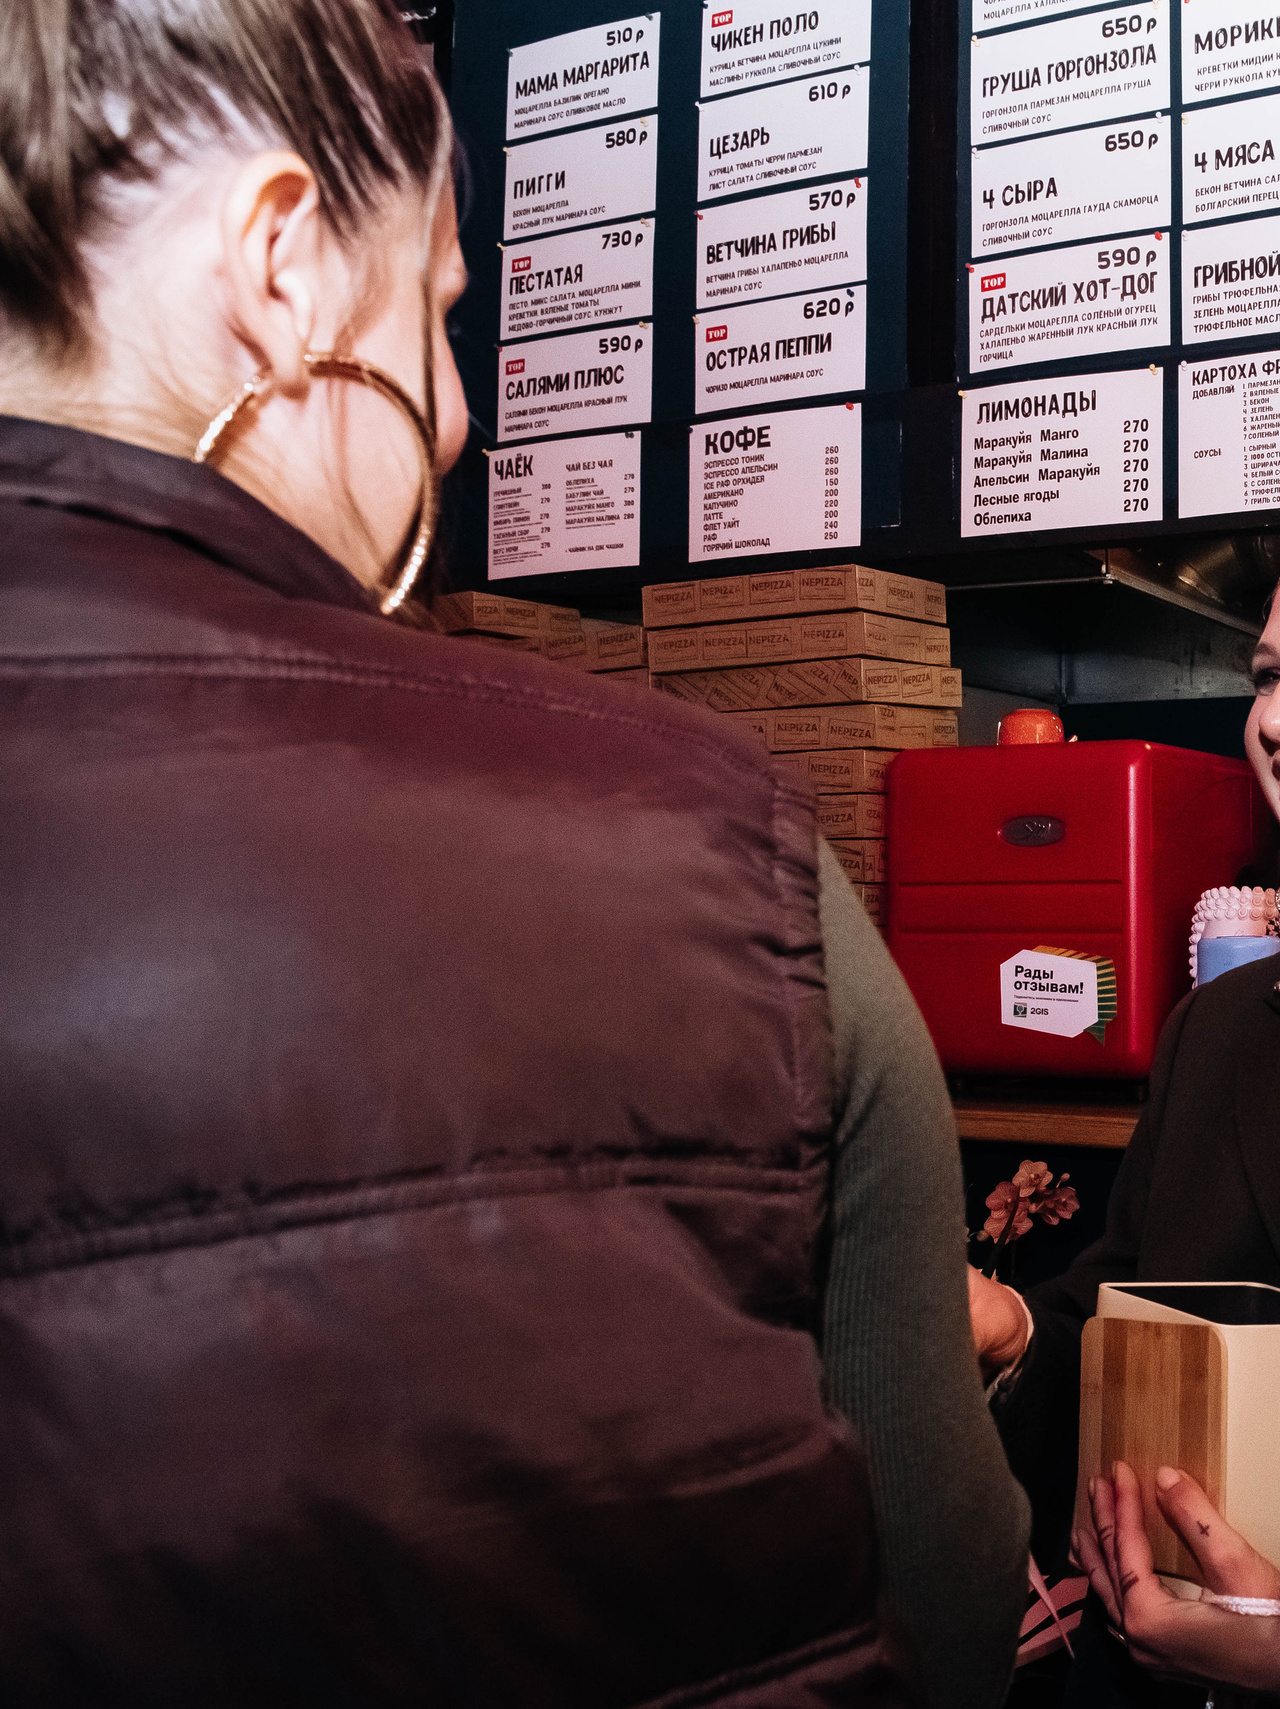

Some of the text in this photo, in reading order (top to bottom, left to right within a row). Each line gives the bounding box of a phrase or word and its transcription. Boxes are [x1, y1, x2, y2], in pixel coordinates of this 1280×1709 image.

[711, 11, 818, 51] ЧИКЕН ПОЛО
[714, 13, 731, 24] TOP
[516, 51, 649, 99] МАМА МАРГАРИТА
[983, 44, 1156, 98] ГРУША ГОРГОНЗОЛА
[710, 128, 769, 159] ЦЕЗАРЬ
[1195, 140, 1274, 172] 4 МЯСА
[514, 171, 565, 199] ПИГГИ
[983, 177, 1057, 209] 4 СЫРА
[707, 221, 835, 264] ВЕТЧИНА ГРИБЫ
[514, 260, 529, 269] TOP
[510, 264, 582, 296] ПЕСТАТАЯ
[983, 277, 1004, 288] TOP
[981, 272, 1157, 324] ДАТСКИЙ ХОТ-ДОГ
[1193, 293, 1220, 304] ГРИБЫ
[708, 329, 726, 339] TOP
[706, 332, 831, 371] ОСТРАЯ ПЕППИ
[508, 363, 523, 371] TOP
[729, 377, 768, 389] МОЦАРЕЛЛА
[806, 368, 823, 378] СОУС
[1193, 362, 1257, 386] КАРТОХА
[506, 365, 624, 400] САЛЯМИ ПЛЮС
[977, 390, 1096, 424] ЛИМОНАДЫ
[705, 426, 771, 455] КОФЕ
[974, 419, 1148, 451] Маракуйя Манго 270
[825, 446, 839, 454] 260
[974, 439, 1148, 470] Маракуйя Малина 270
[495, 453, 533, 480] ЧАЁК
[974, 458, 1148, 488] Апельсин Маракуйя 270
[826, 478, 838, 486] 150
[974, 478, 1148, 507] Лесные ягоды 270
[974, 498, 1148, 526] Облепиха 270
[801, 576, 843, 588] NEPIZZA
[748, 633, 790, 646] NEPIZZA
[866, 675, 898, 685] NEPIZZA
[902, 672, 931, 685] NEPIZZA
[777, 722, 818, 733] NEPIZZA
[830, 725, 872, 739] NEPIZZA
[810, 763, 850, 775] NEPIZZA
[1015, 965, 1053, 980] Рады
[1014, 981, 1083, 994] отзывам!
